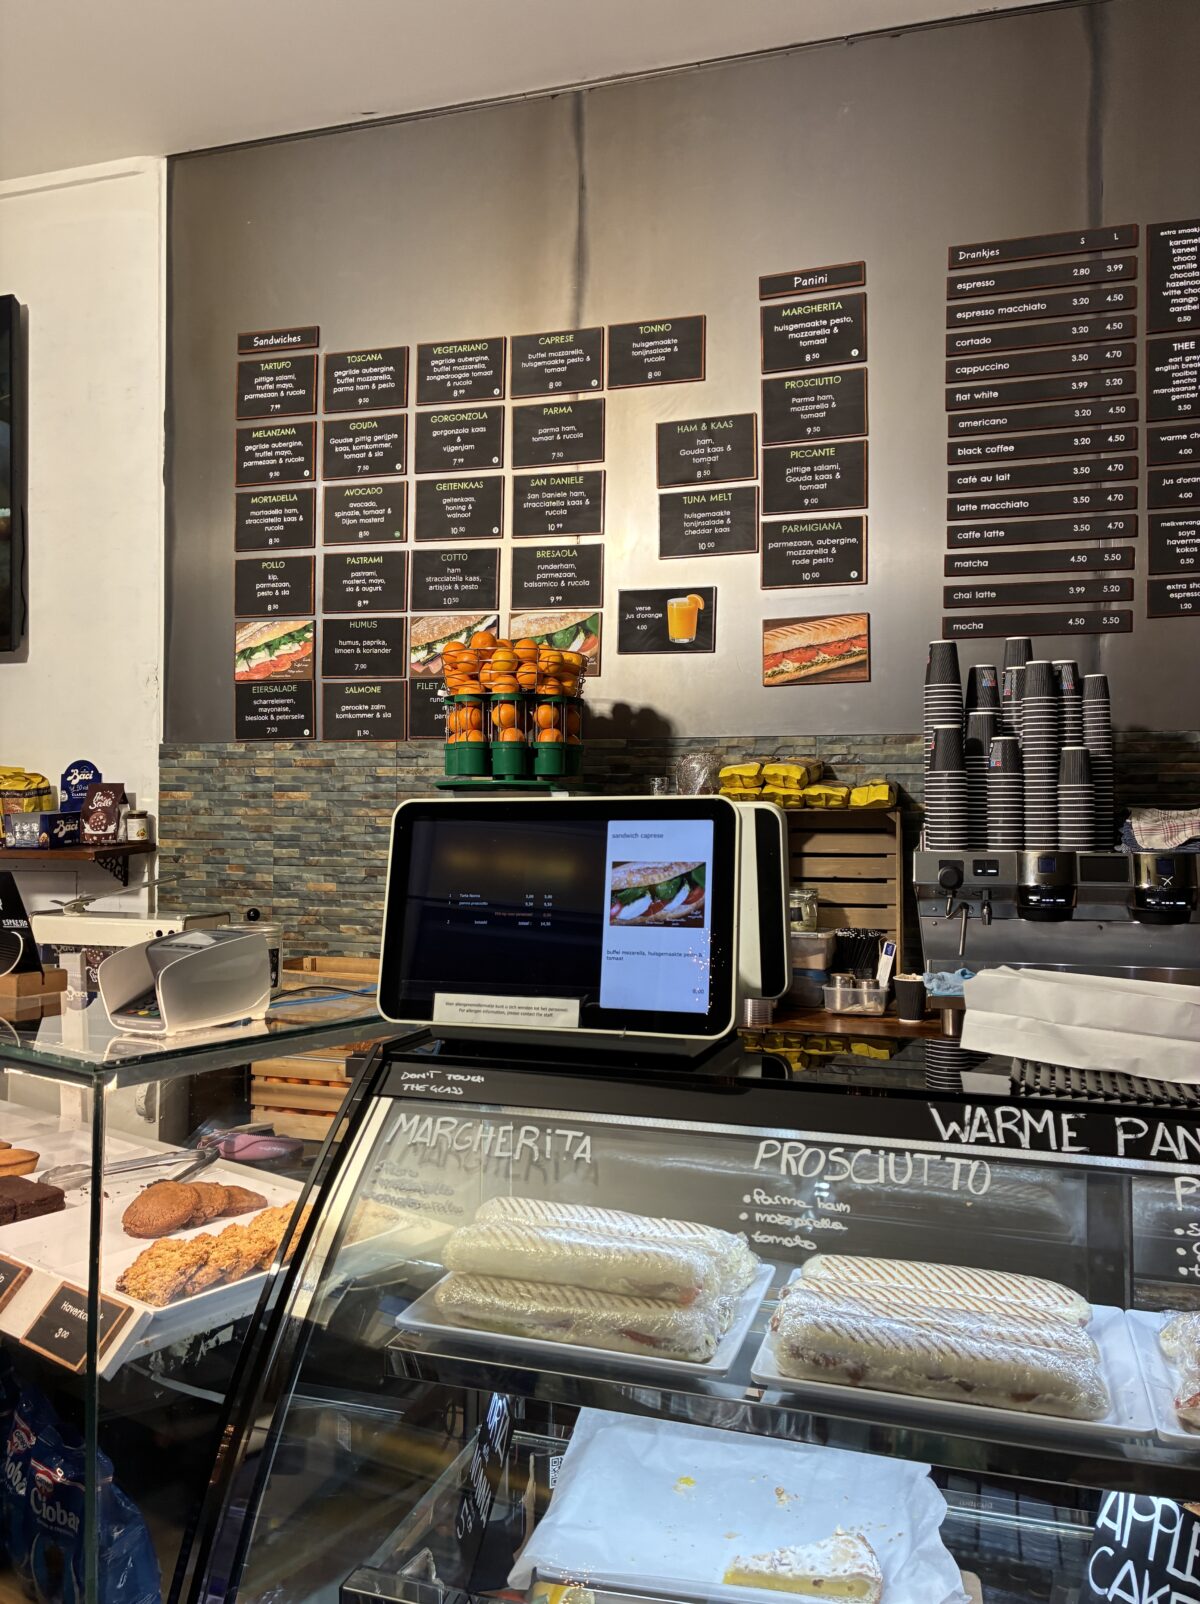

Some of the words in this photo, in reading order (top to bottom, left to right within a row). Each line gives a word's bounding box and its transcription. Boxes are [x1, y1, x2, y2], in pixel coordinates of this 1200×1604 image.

[958, 249, 1000, 260] Drankjes
[1080, 237, 1085, 245] S
[1172, 246, 1198, 254] kaneel
[1172, 262, 1198, 270] vanille
[794, 274, 828, 288] Panini
[956, 280, 995, 290] espresso
[1073, 268, 1090, 276] 2.80
[1106, 264, 1123, 272] 3.99
[1171, 296, 1198, 304] mango
[782, 301, 843, 317] MARGHERITA
[956, 309, 995, 320] espresso
[998, 302, 1047, 314] macchiato
[1072, 297, 1089, 306] 3.20
[1106, 293, 1124, 302] 4.50
[774, 320, 827, 332] huisgemaakte
[830, 316, 853, 326] pesto,
[1177, 315, 1192, 323] 0.50
[639, 323, 672, 334] TONNO
[788, 328, 830, 339] mozzarella
[253, 333, 302, 347] Sandwiches
[539, 334, 574, 345] CAPRESE
[955, 337, 992, 347] cortado
[1072, 326, 1089, 334] 3.20
[1105, 322, 1123, 330] 4.50
[799, 337, 827, 347] tomaat
[1172, 341, 1195, 351] THEE
[433, 343, 488, 354] VEGETARIANO
[347, 353, 383, 363] TOSCANA
[644, 355, 666, 363] rucola
[955, 362, 1010, 375] cappuccino
[1071, 354, 1089, 362] 3.50
[1105, 350, 1122, 358] 4.70
[260, 361, 291, 371] TARTUFO
[785, 375, 841, 389] PROSCIUTTO
[1172, 377, 1197, 385] sencha
[955, 393, 971, 401] flat
[973, 391, 999, 399] white
[1071, 381, 1088, 390] 3.99
[1105, 378, 1123, 386] 5.20
[1171, 393, 1198, 401] gember
[543, 406, 573, 415] PARMA
[430, 412, 488, 423] GORGONZOLA
[958, 418, 1008, 428] americano
[1074, 409, 1092, 417] 3.20
[1108, 406, 1126, 414] 4.50
[349, 421, 378, 430] GOUDA
[677, 424, 698, 434] HAM
[701, 422, 707, 431] &
[711, 420, 733, 430] KAAS
[252, 427, 296, 438] MELANZANA
[957, 446, 982, 456] black
[985, 444, 1015, 453] coffee
[1074, 437, 1091, 446] 3.20
[1108, 434, 1125, 442] 4.50
[790, 447, 835, 459] PICCANTE
[786, 466, 811, 475] pittige
[813, 463, 841, 471] salami,
[957, 476, 977, 484] café
[996, 473, 1010, 482] lait
[1073, 466, 1090, 475] 3.50
[1107, 464, 1124, 472] 4.70
[530, 478, 547, 487] SAN
[550, 476, 584, 485] DANIELE
[785, 475, 812, 483] Gouda
[344, 487, 383, 496] AVOCADO
[436, 481, 483, 491] GEITENKAAS
[799, 482, 827, 491] tomaat
[251, 494, 298, 504] MORTADELLA
[682, 495, 706, 504] TUNA
[710, 493, 732, 502] MELT
[957, 504, 978, 512] latte
[980, 500, 1029, 510] macchiato
[1073, 496, 1090, 504] 3.50
[1107, 494, 1124, 502] 4.70
[782, 522, 842, 533] PARMIGIANA
[957, 531, 981, 539] caffe
[984, 530, 1005, 538] latte
[1073, 524, 1090, 532] 3.50
[1107, 521, 1124, 529] 4.70
[440, 553, 468, 562] COTTO
[536, 549, 578, 558] BRESAOLA
[786, 548, 828, 556] mozzarella
[262, 561, 285, 569] POLLO
[346, 556, 383, 564] PASTRAMI
[954, 560, 989, 568] matcha
[1070, 555, 1087, 563] 4.50
[1104, 553, 1121, 561] 5.50
[975, 591, 996, 599] latte
[1069, 586, 1085, 594] 3.99
[1103, 585, 1120, 593] 5.20
[953, 622, 984, 630] mocha
[252, 684, 297, 694] EIERSALADE
[345, 686, 381, 694] SALMONE
[417, 682, 439, 690] FILET
[66, 769, 94, 785] Baci
[53, 820, 79, 838] Baci
[612, 831, 638, 839] sandwich
[400, 1071, 442, 1080] DON'T
[446, 1073, 485, 1083] TOUCH
[403, 1083, 428, 1092] THE
[429, 1084, 464, 1095] GLASS
[928, 1102, 1091, 1154] WARME
